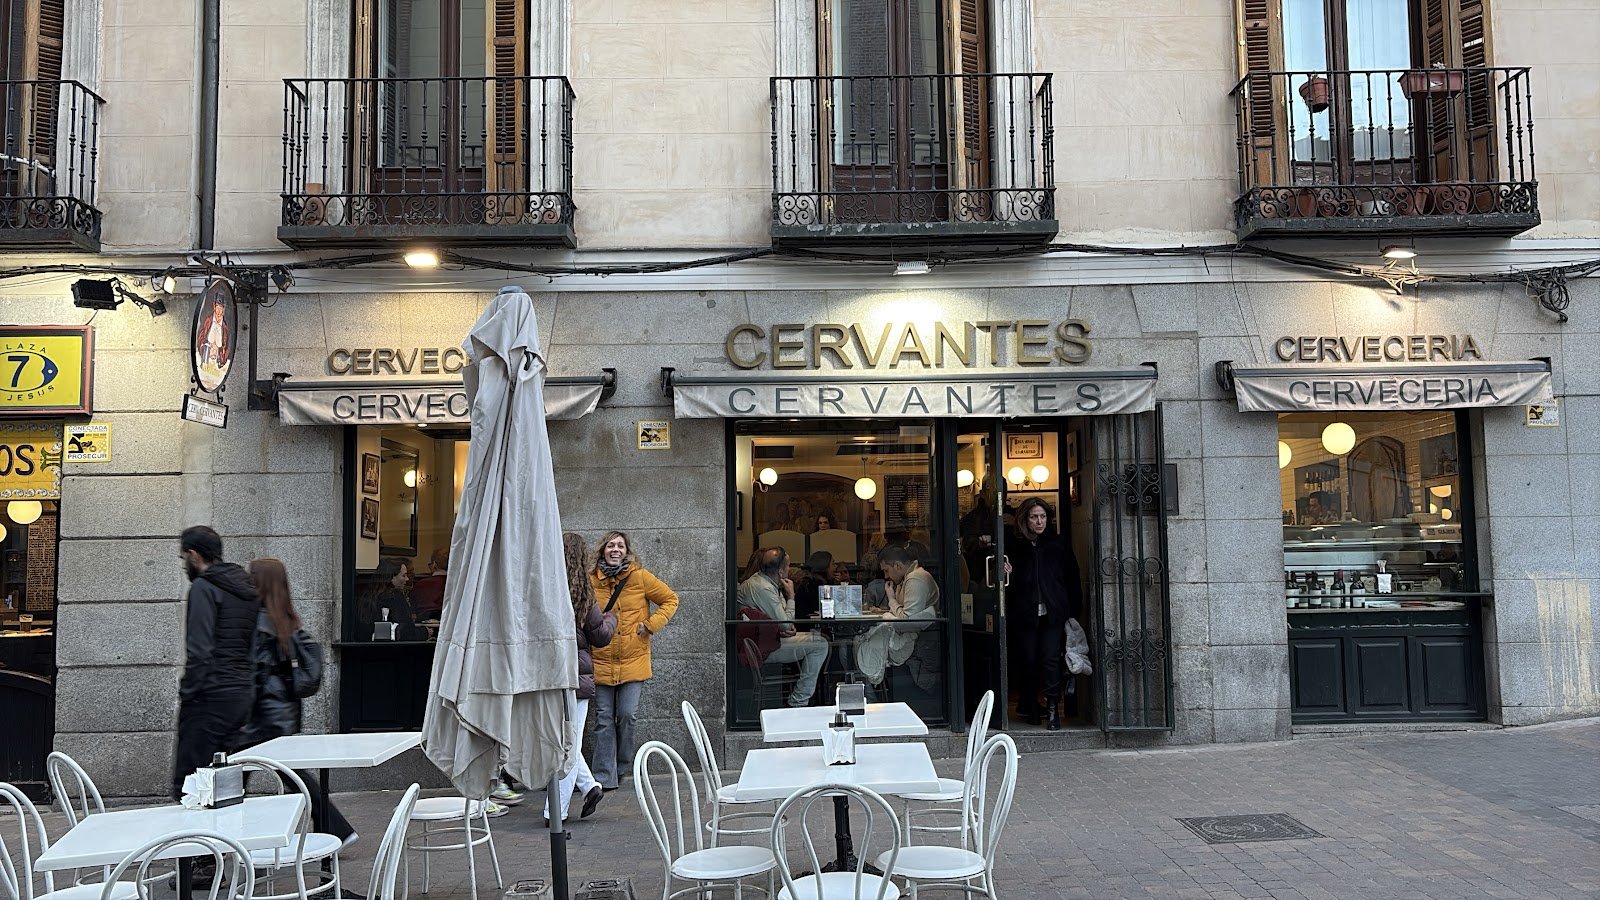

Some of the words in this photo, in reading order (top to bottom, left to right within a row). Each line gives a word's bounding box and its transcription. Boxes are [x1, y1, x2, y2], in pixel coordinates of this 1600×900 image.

[724, 317, 1093, 369] CERVANTES
[1276, 334, 1482, 361] CERVECERIA
[8, 355, 30, 388] 7
[328, 347, 475, 374] CERVEC
[7, 384, 55, 401] JESUS
[728, 382, 1102, 415] CERVANTES
[1288, 377, 1500, 405] CERVECERIA
